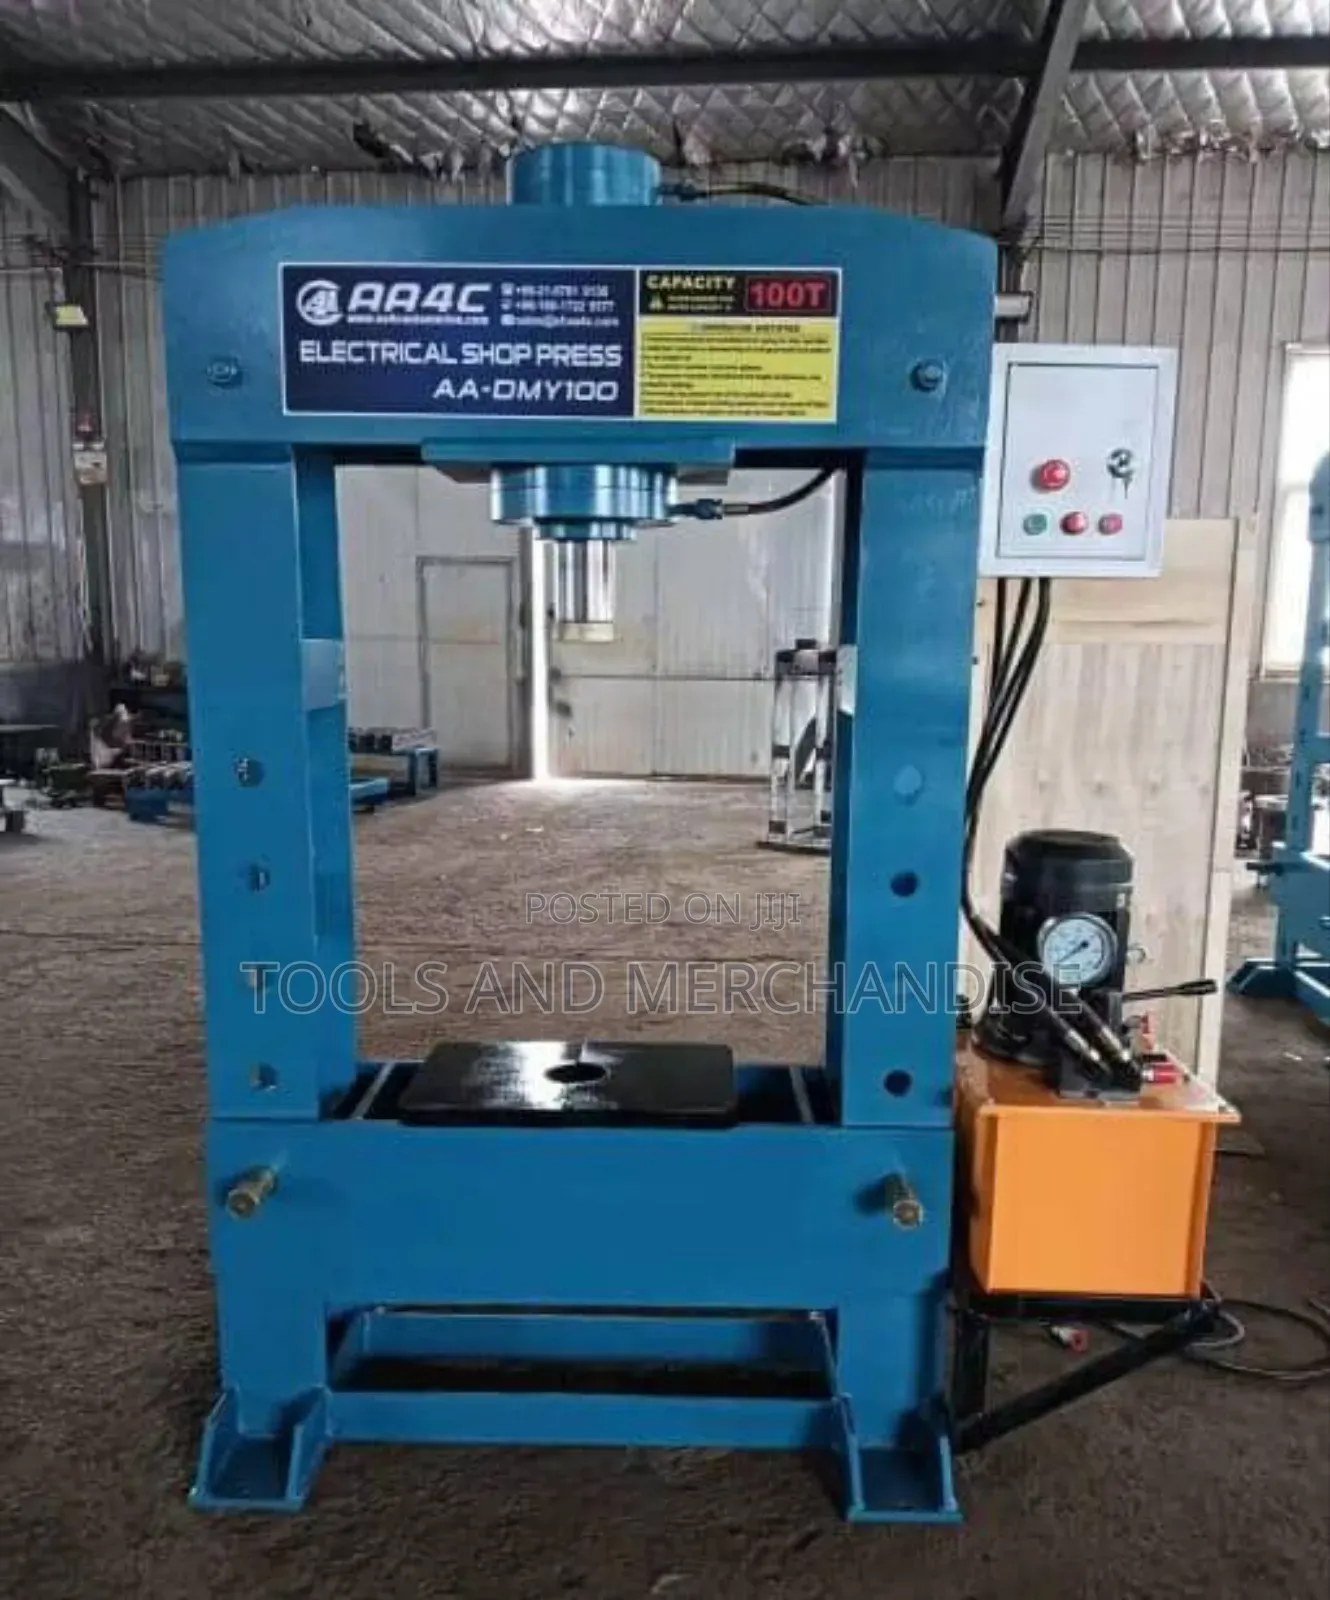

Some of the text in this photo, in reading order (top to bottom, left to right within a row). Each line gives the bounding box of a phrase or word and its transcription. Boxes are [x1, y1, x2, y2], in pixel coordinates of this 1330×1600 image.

[646, 274, 736, 290] CAPACITY
[750, 281, 826, 308] 100T
[347, 282, 491, 312] AA4C
[299, 340, 457, 365] ELECTRICAL
[461, 342, 531, 366] SHOP
[536, 344, 622, 368] PRESS
[432, 378, 618, 402] AA-DMY100
